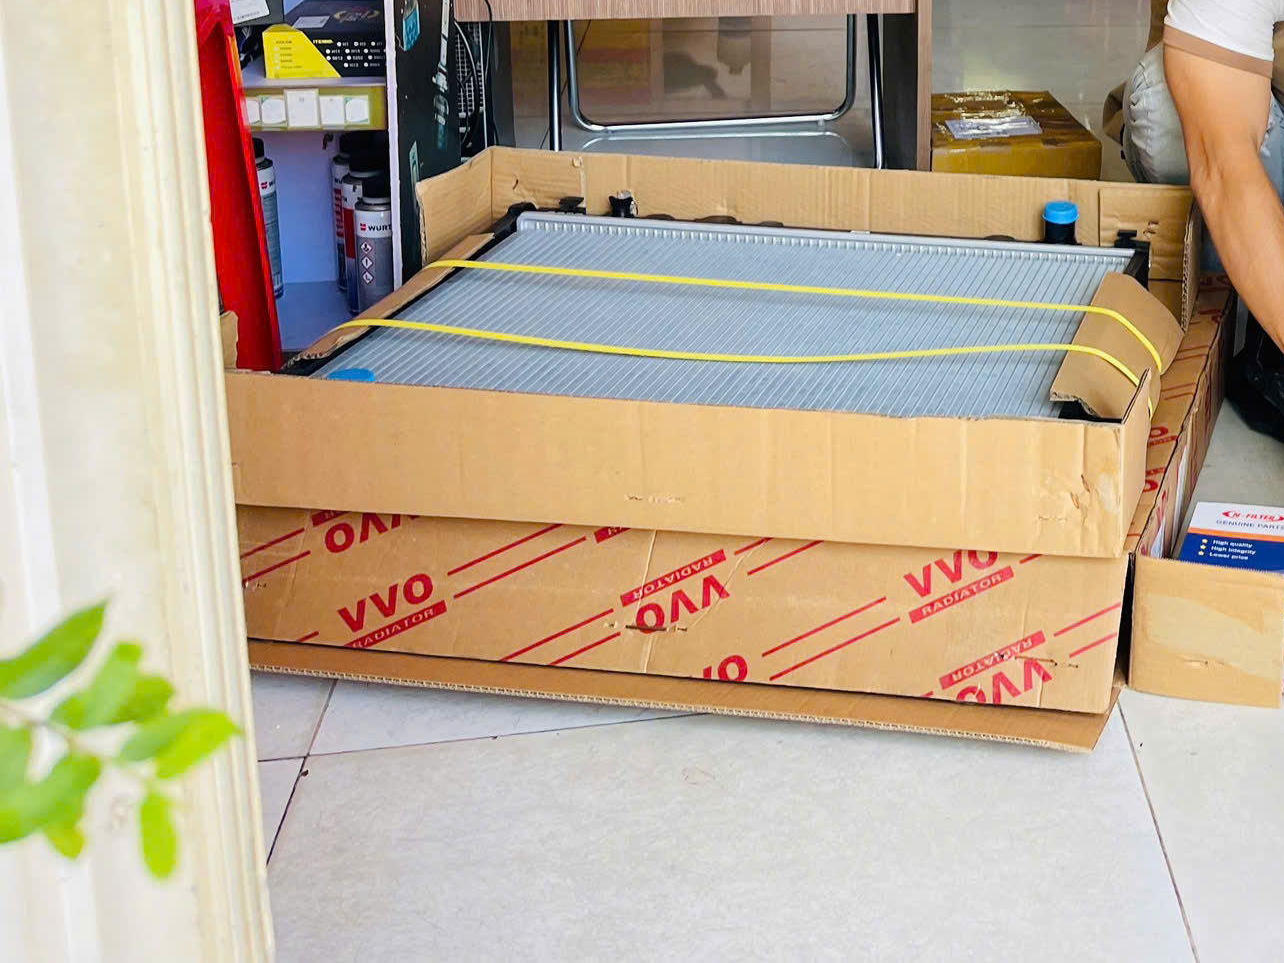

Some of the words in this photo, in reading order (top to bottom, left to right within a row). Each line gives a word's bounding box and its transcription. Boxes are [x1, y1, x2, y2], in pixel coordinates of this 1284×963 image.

[1216, 519, 1255, 528] GENUINE
[1211, 545, 1228, 553] High
[1228, 548, 1256, 556] integrity
[633, 556, 713, 600] RADIATOR
[921, 574, 1002, 617] RADIATOR
[337, 572, 434, 633] VVO
[636, 574, 730, 634] VVO
[352, 607, 434, 648] RADIATOR
